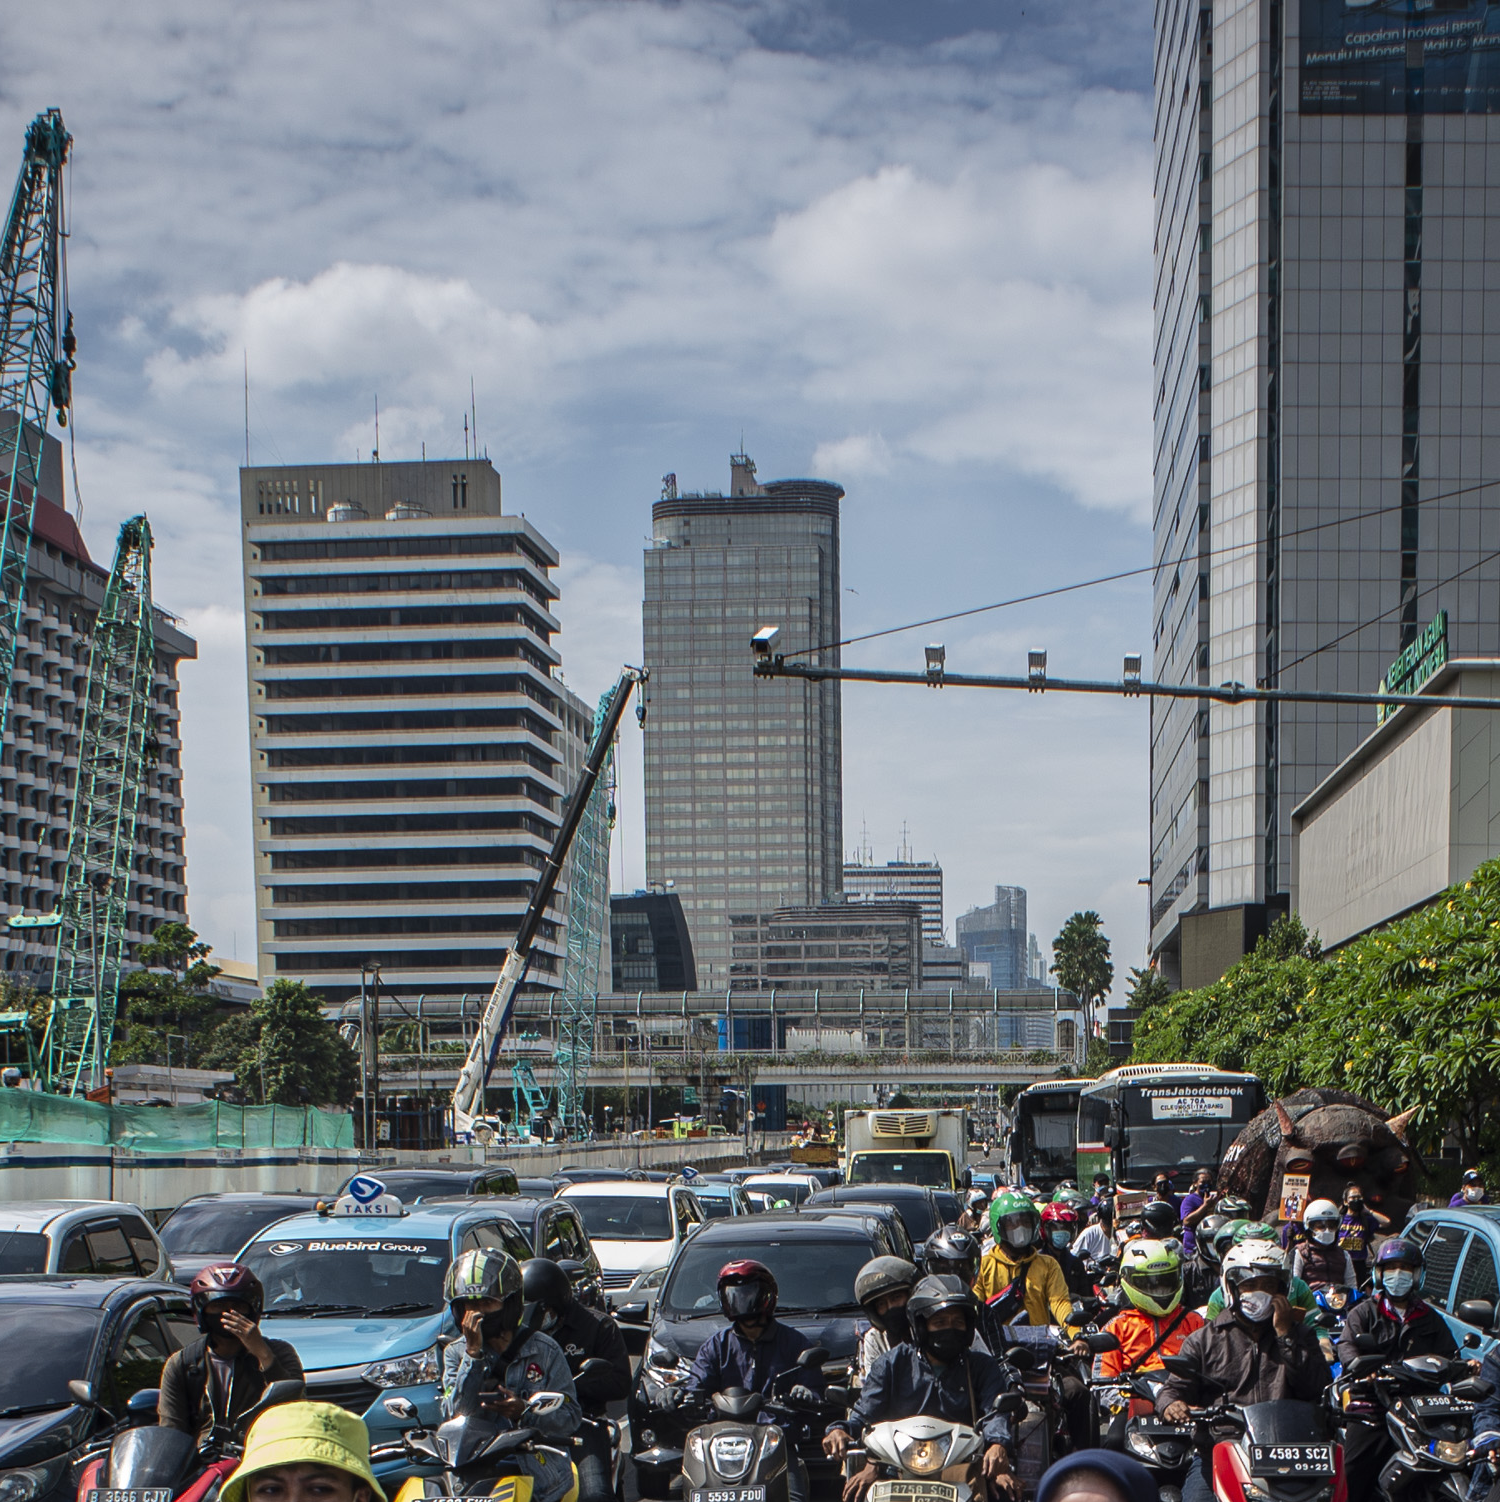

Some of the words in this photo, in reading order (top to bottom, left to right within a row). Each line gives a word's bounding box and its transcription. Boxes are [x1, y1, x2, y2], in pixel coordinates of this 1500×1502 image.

[1345, 28, 1400, 45] Capaian
[1403, 23, 1449, 40] Inovasi
[1140, 1087, 1244, 1098] TransJabodetabek
[345, 1205, 389, 1214] TAKSI
[308, 1241, 381, 1252] Bluebird
[382, 1243, 427, 1253] Group
[1416, 1399, 1424, 1407] B
[1254, 1448, 1262, 1460] B
[1269, 1448, 1300, 1459] 4583
[1305, 1448, 1328, 1460] SCZ
[708, 1491, 736, 1502] 5593
[740, 1489, 761, 1501] FDU
[893, 1484, 924, 1495] 3758
[105, 1490, 137, 1502] 3666
[143, 1490, 168, 1502] CJY
